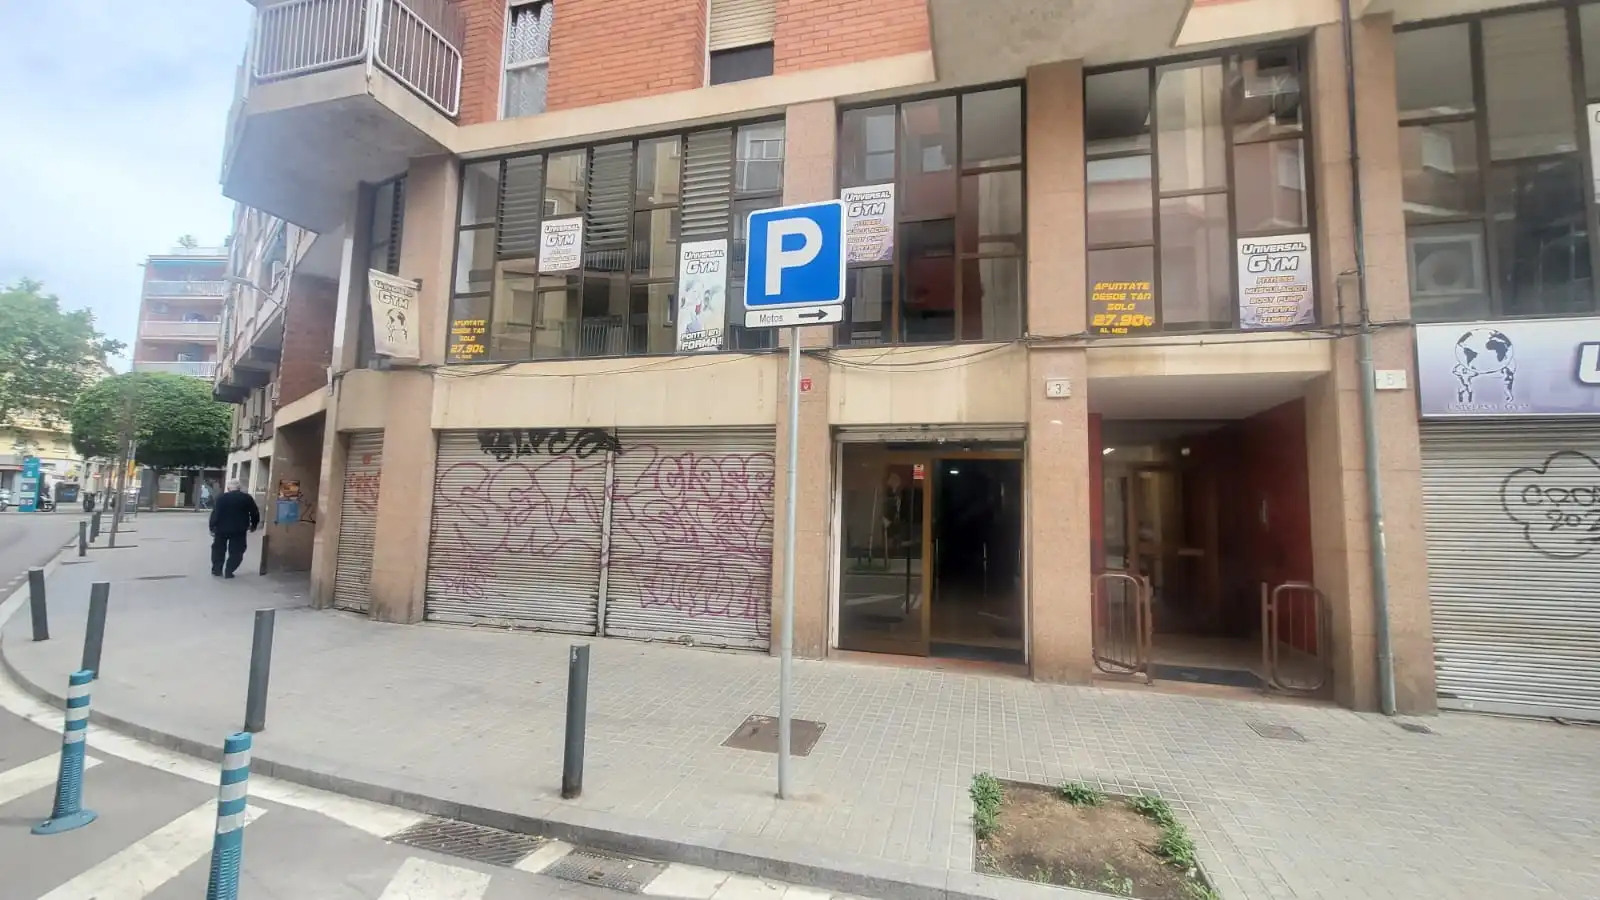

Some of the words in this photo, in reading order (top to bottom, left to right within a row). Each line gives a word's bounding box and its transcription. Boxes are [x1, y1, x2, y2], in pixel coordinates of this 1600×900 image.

[845, 191, 891, 203] UNIVERSAL
[848, 202, 886, 217] GYM
[545, 233, 575, 247] GYM
[1242, 242, 1307, 254] UNIVERSAL
[765, 217, 823, 296] P
[1248, 254, 1299, 273] GYM
[686, 260, 720, 274] GYM
[378, 290, 410, 310] GYM
[759, 314, 784, 324] Motos
